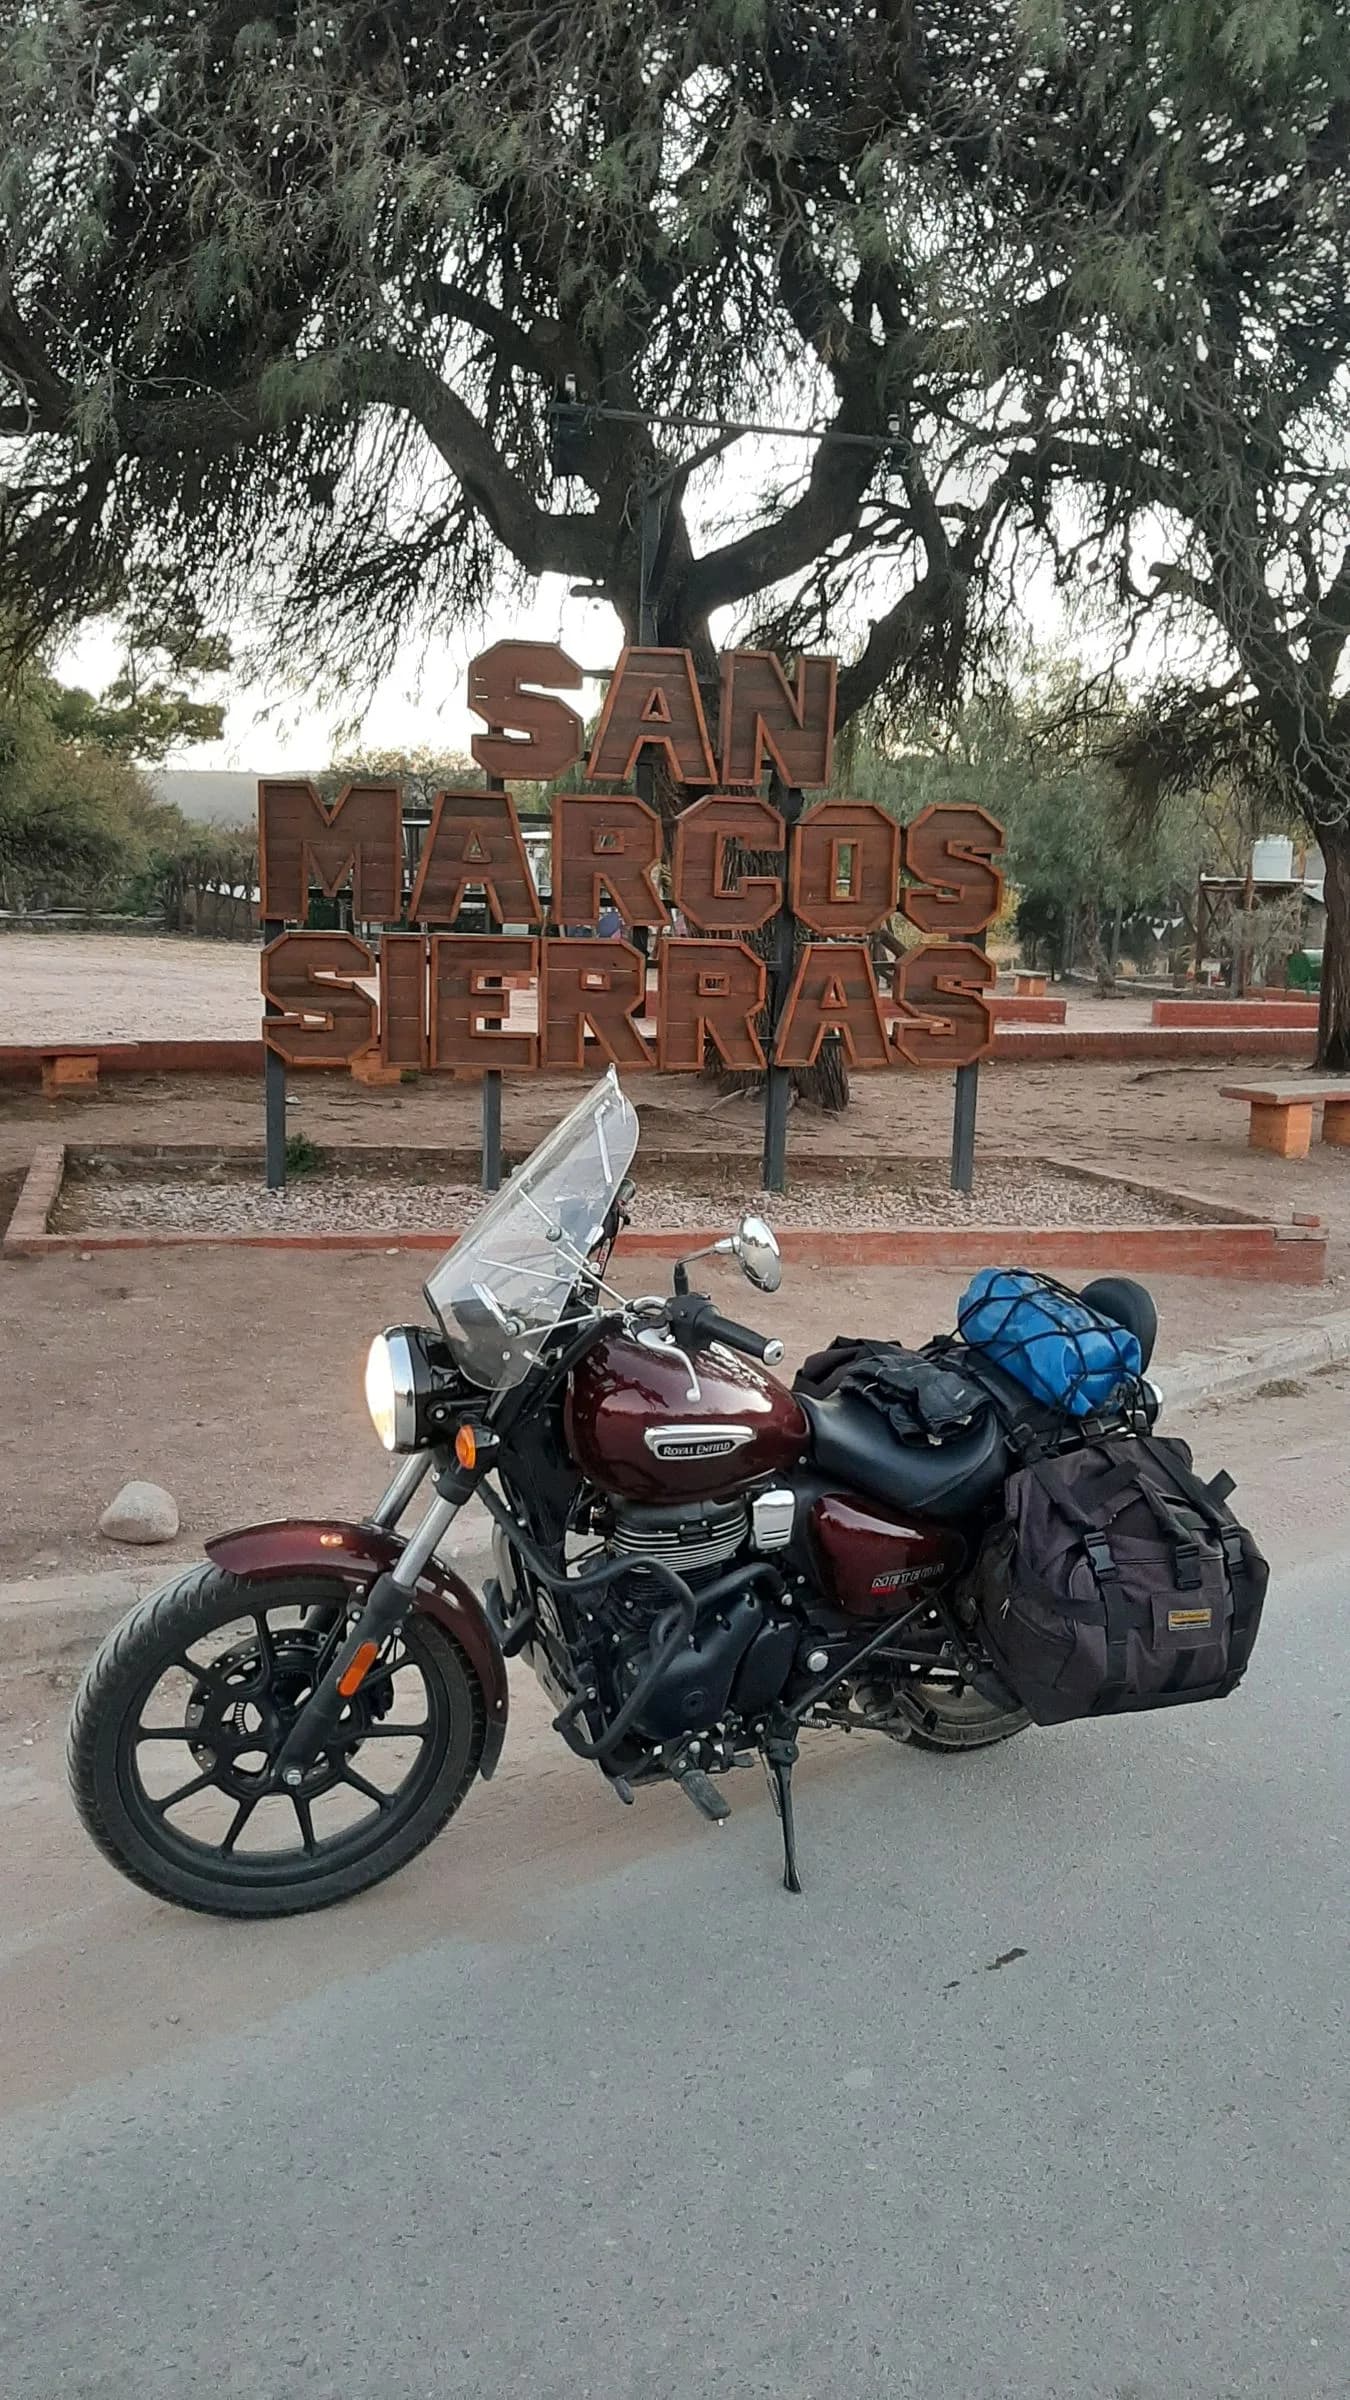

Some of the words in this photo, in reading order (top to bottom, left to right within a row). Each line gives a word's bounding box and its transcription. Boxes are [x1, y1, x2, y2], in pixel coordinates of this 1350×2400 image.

[468, 640, 838, 789] SAN
[258, 779, 1004, 934] MARCOS
[260, 930, 996, 1071] SIERRAS
[663, 1444, 694, 1456] ROYAL
[696, 1441, 731, 1455] ENFIELD
